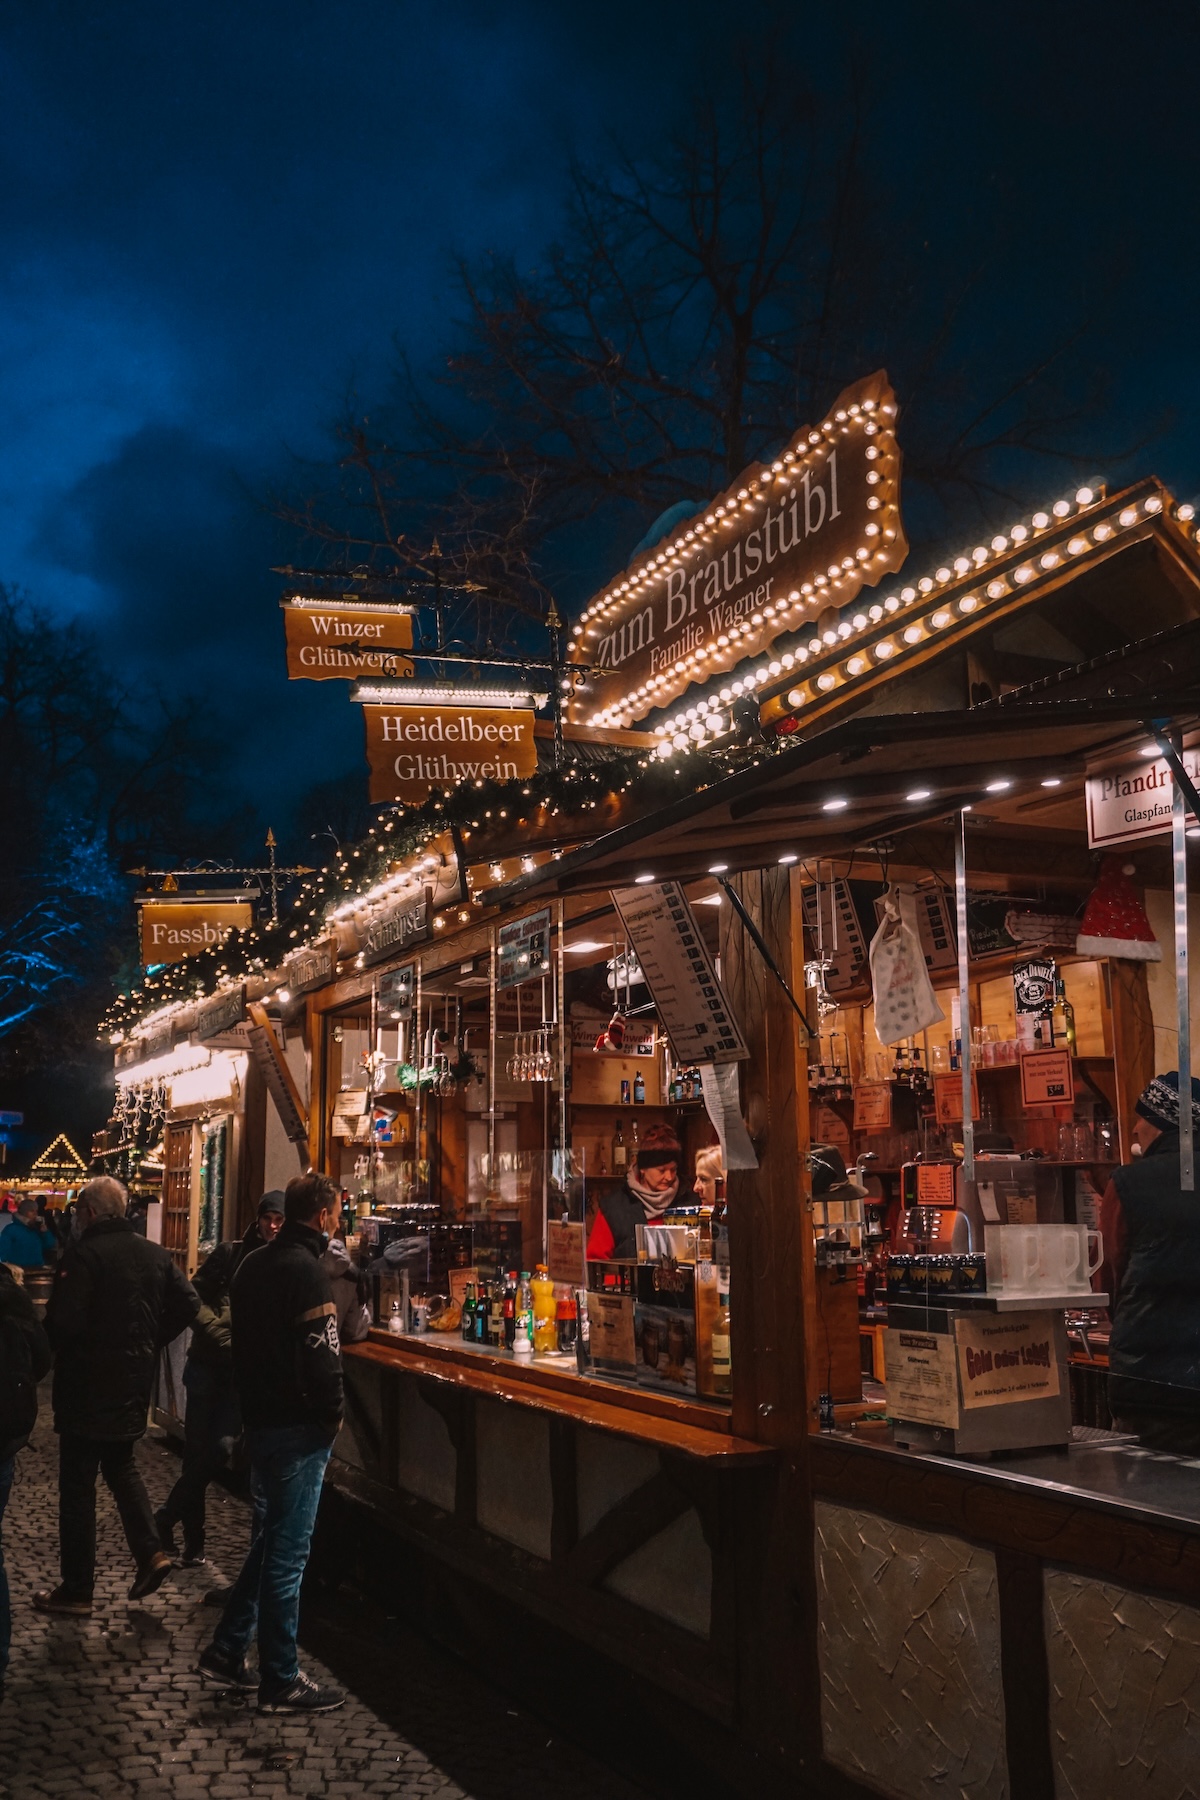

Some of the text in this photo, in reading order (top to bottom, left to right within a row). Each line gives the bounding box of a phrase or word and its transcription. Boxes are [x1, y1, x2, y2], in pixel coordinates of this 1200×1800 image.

[597, 449, 841, 668] zum Braustübl
[309, 616, 385, 638] Winzer
[650, 577, 774, 676] Familie Wagner
[380, 716, 525, 742] Heidelbeer
[394, 754, 519, 780] Glühwein
[151, 922, 225, 945] Fassbi
[966, 1346, 993, 1380] Geld
[994, 1349, 1020, 1369] oder
